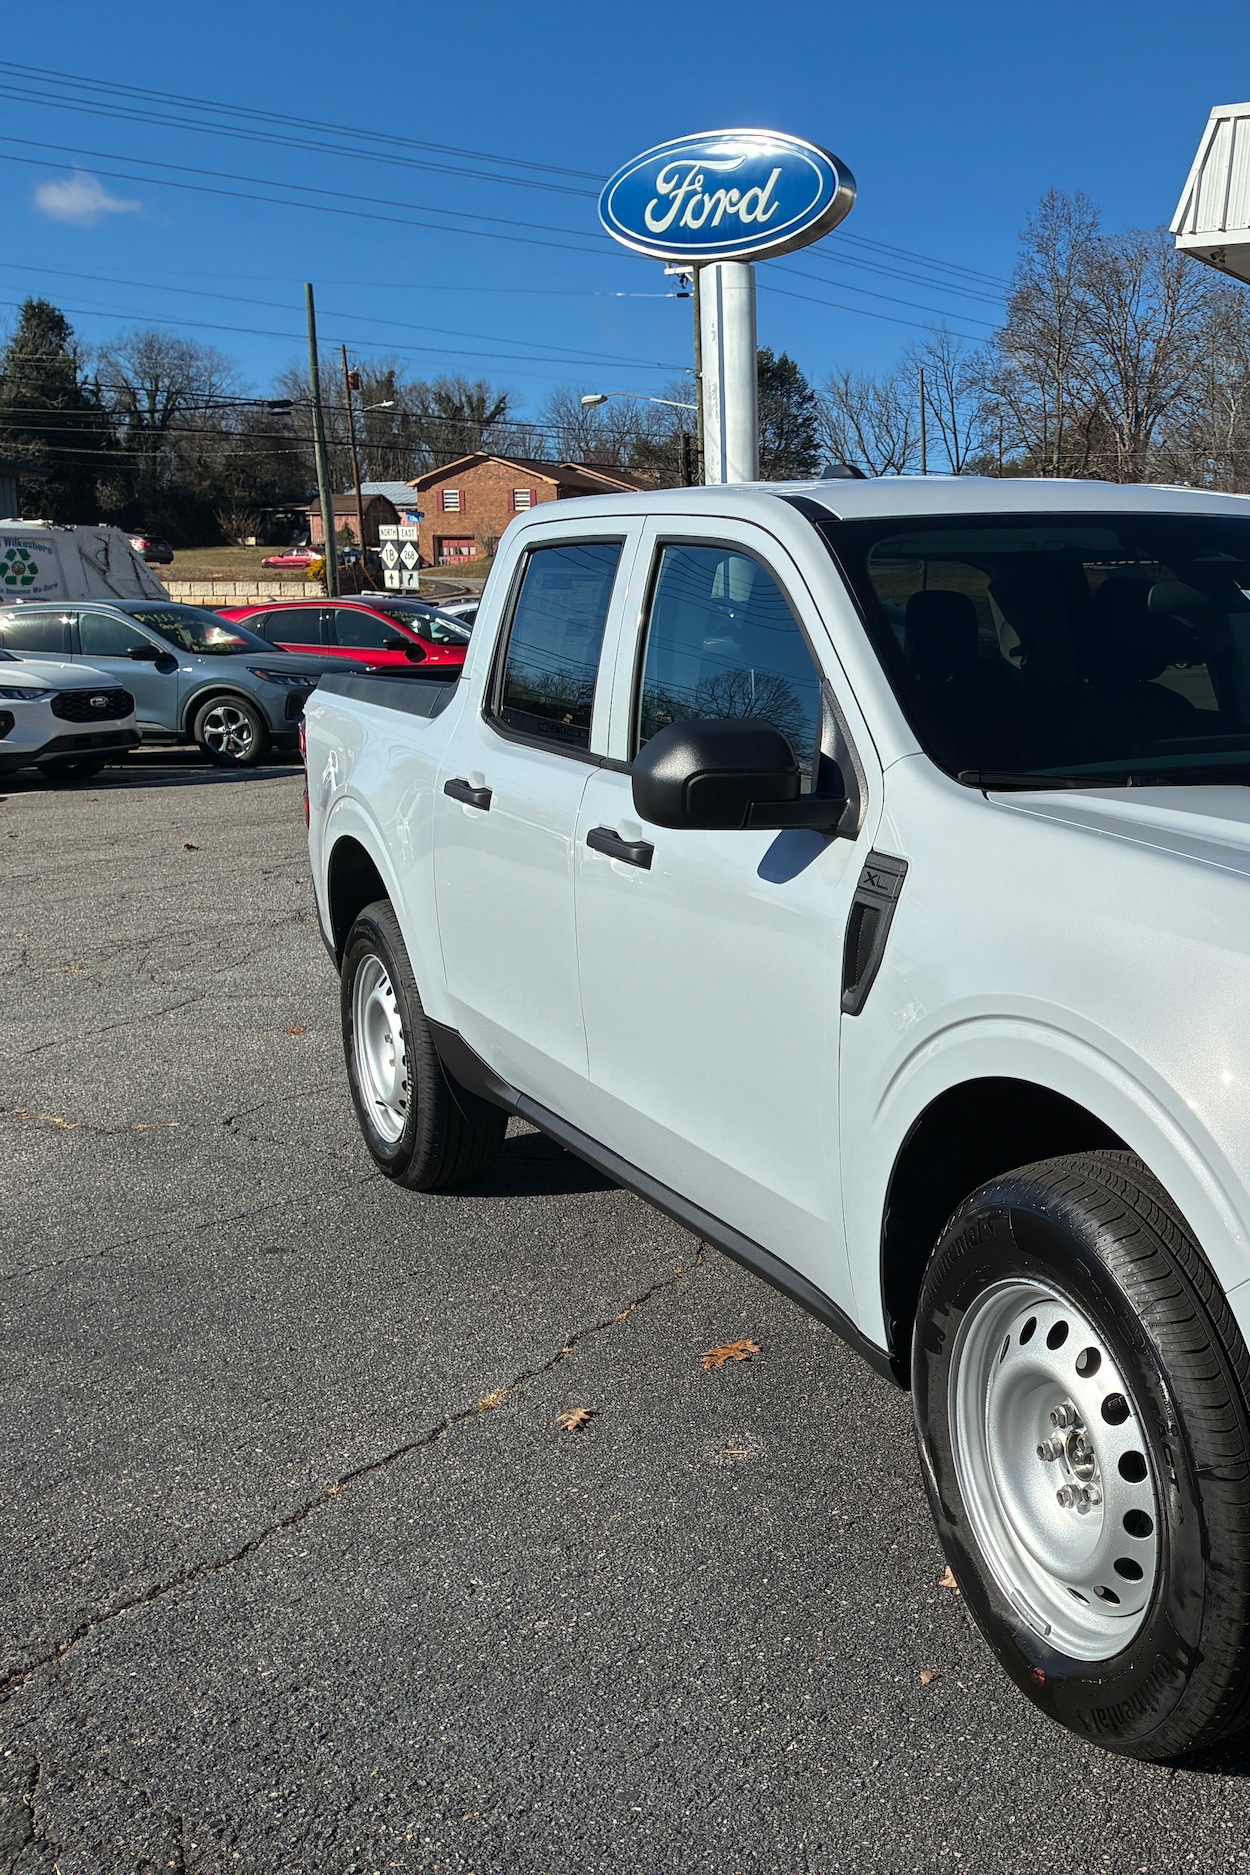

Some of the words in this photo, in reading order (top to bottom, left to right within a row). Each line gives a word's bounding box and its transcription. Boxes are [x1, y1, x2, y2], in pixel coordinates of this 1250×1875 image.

[645, 154, 782, 233] Ford
[380, 528, 397, 536] NORTH
[401, 529, 415, 538] EAST
[385, 548, 395, 562] 18
[404, 550, 415, 560] 268
[863, 871, 889, 891] XL
